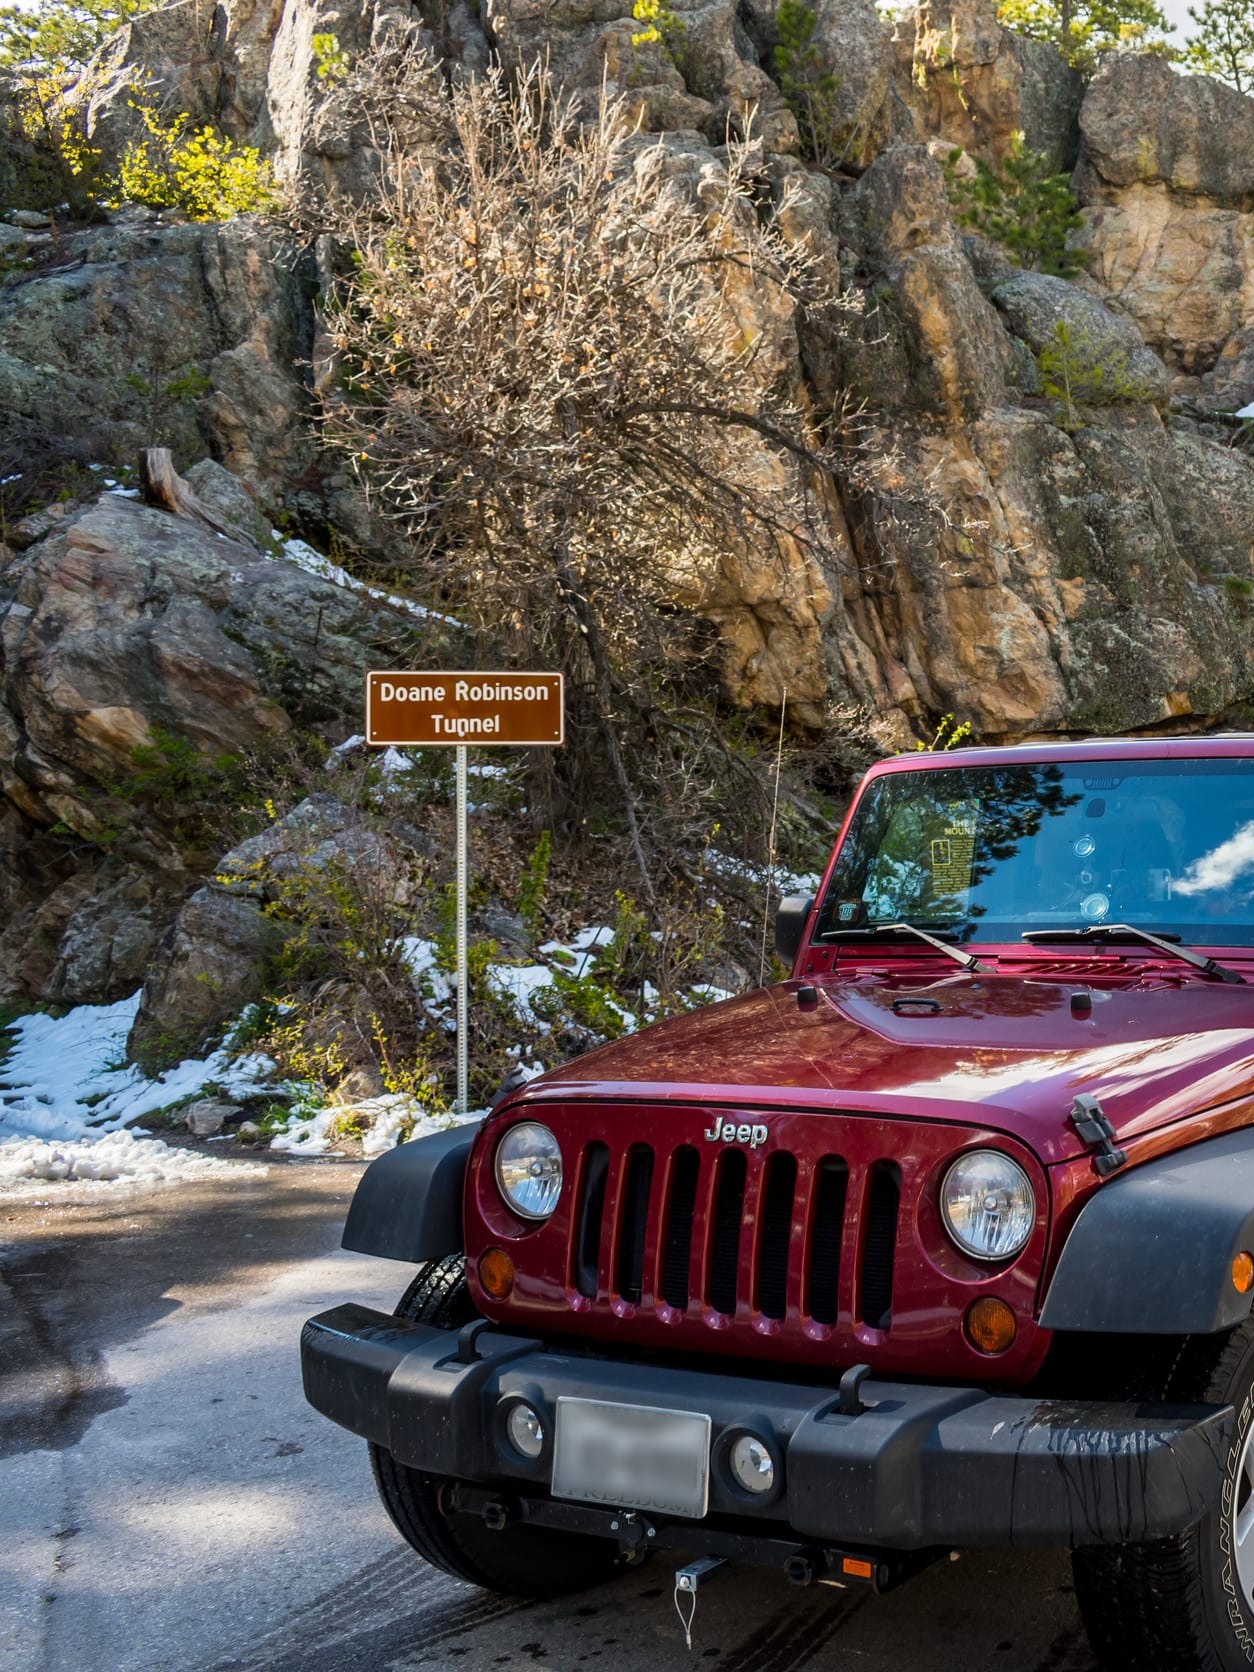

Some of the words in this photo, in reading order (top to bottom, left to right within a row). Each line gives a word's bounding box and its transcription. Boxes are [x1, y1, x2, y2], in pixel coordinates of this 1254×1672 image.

[381, 683, 446, 702] Doane
[455, 680, 549, 701] Robinson
[431, 714, 500, 736] Tunnel
[704, 1116, 768, 1149] Jeep
